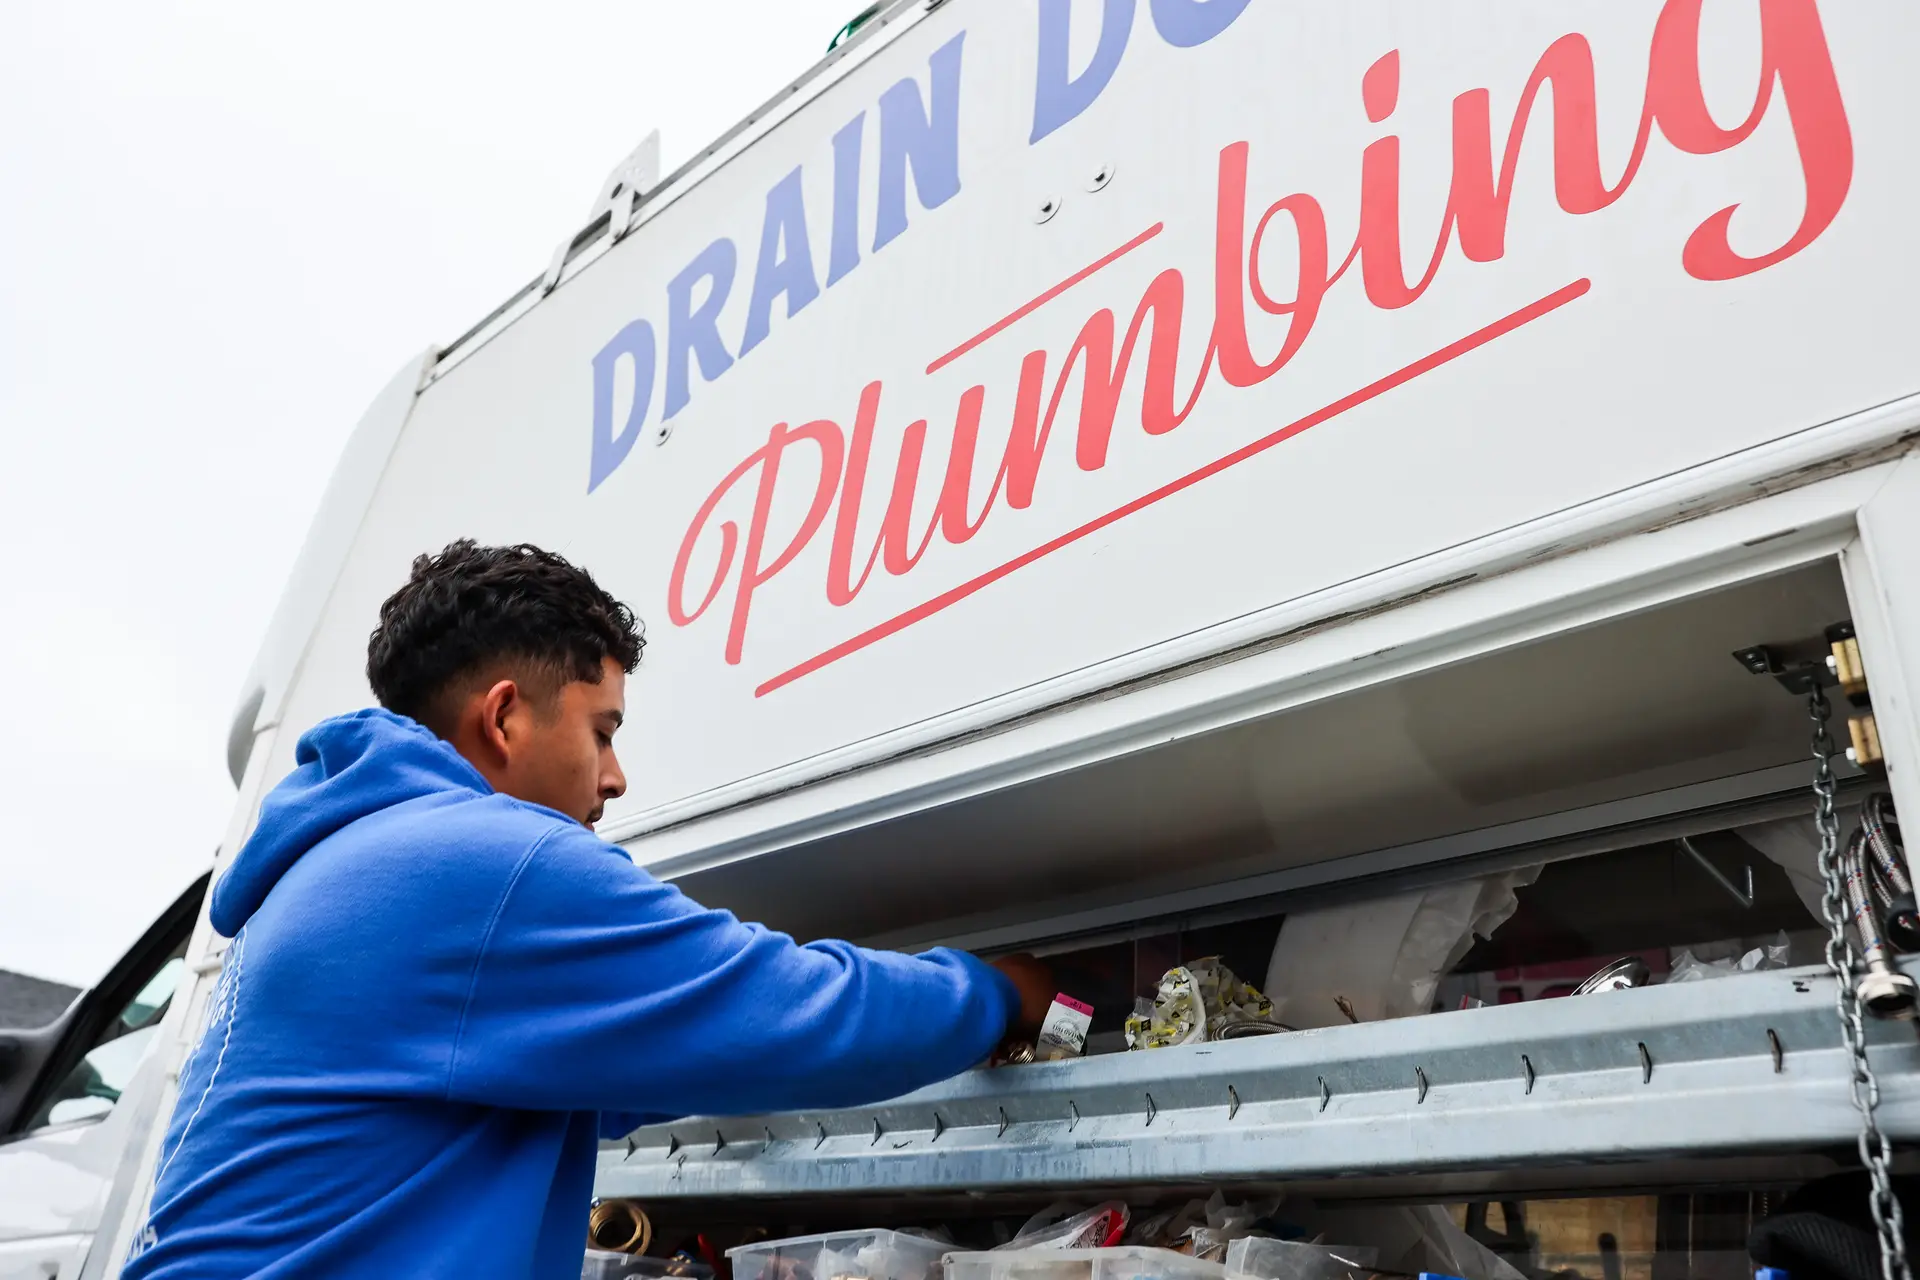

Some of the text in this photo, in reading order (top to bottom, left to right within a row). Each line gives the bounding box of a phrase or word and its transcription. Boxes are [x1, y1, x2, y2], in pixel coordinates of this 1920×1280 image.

[587, 0, 1252, 494] DRAIN D
[669, 0, 1854, 665] Plumbing
